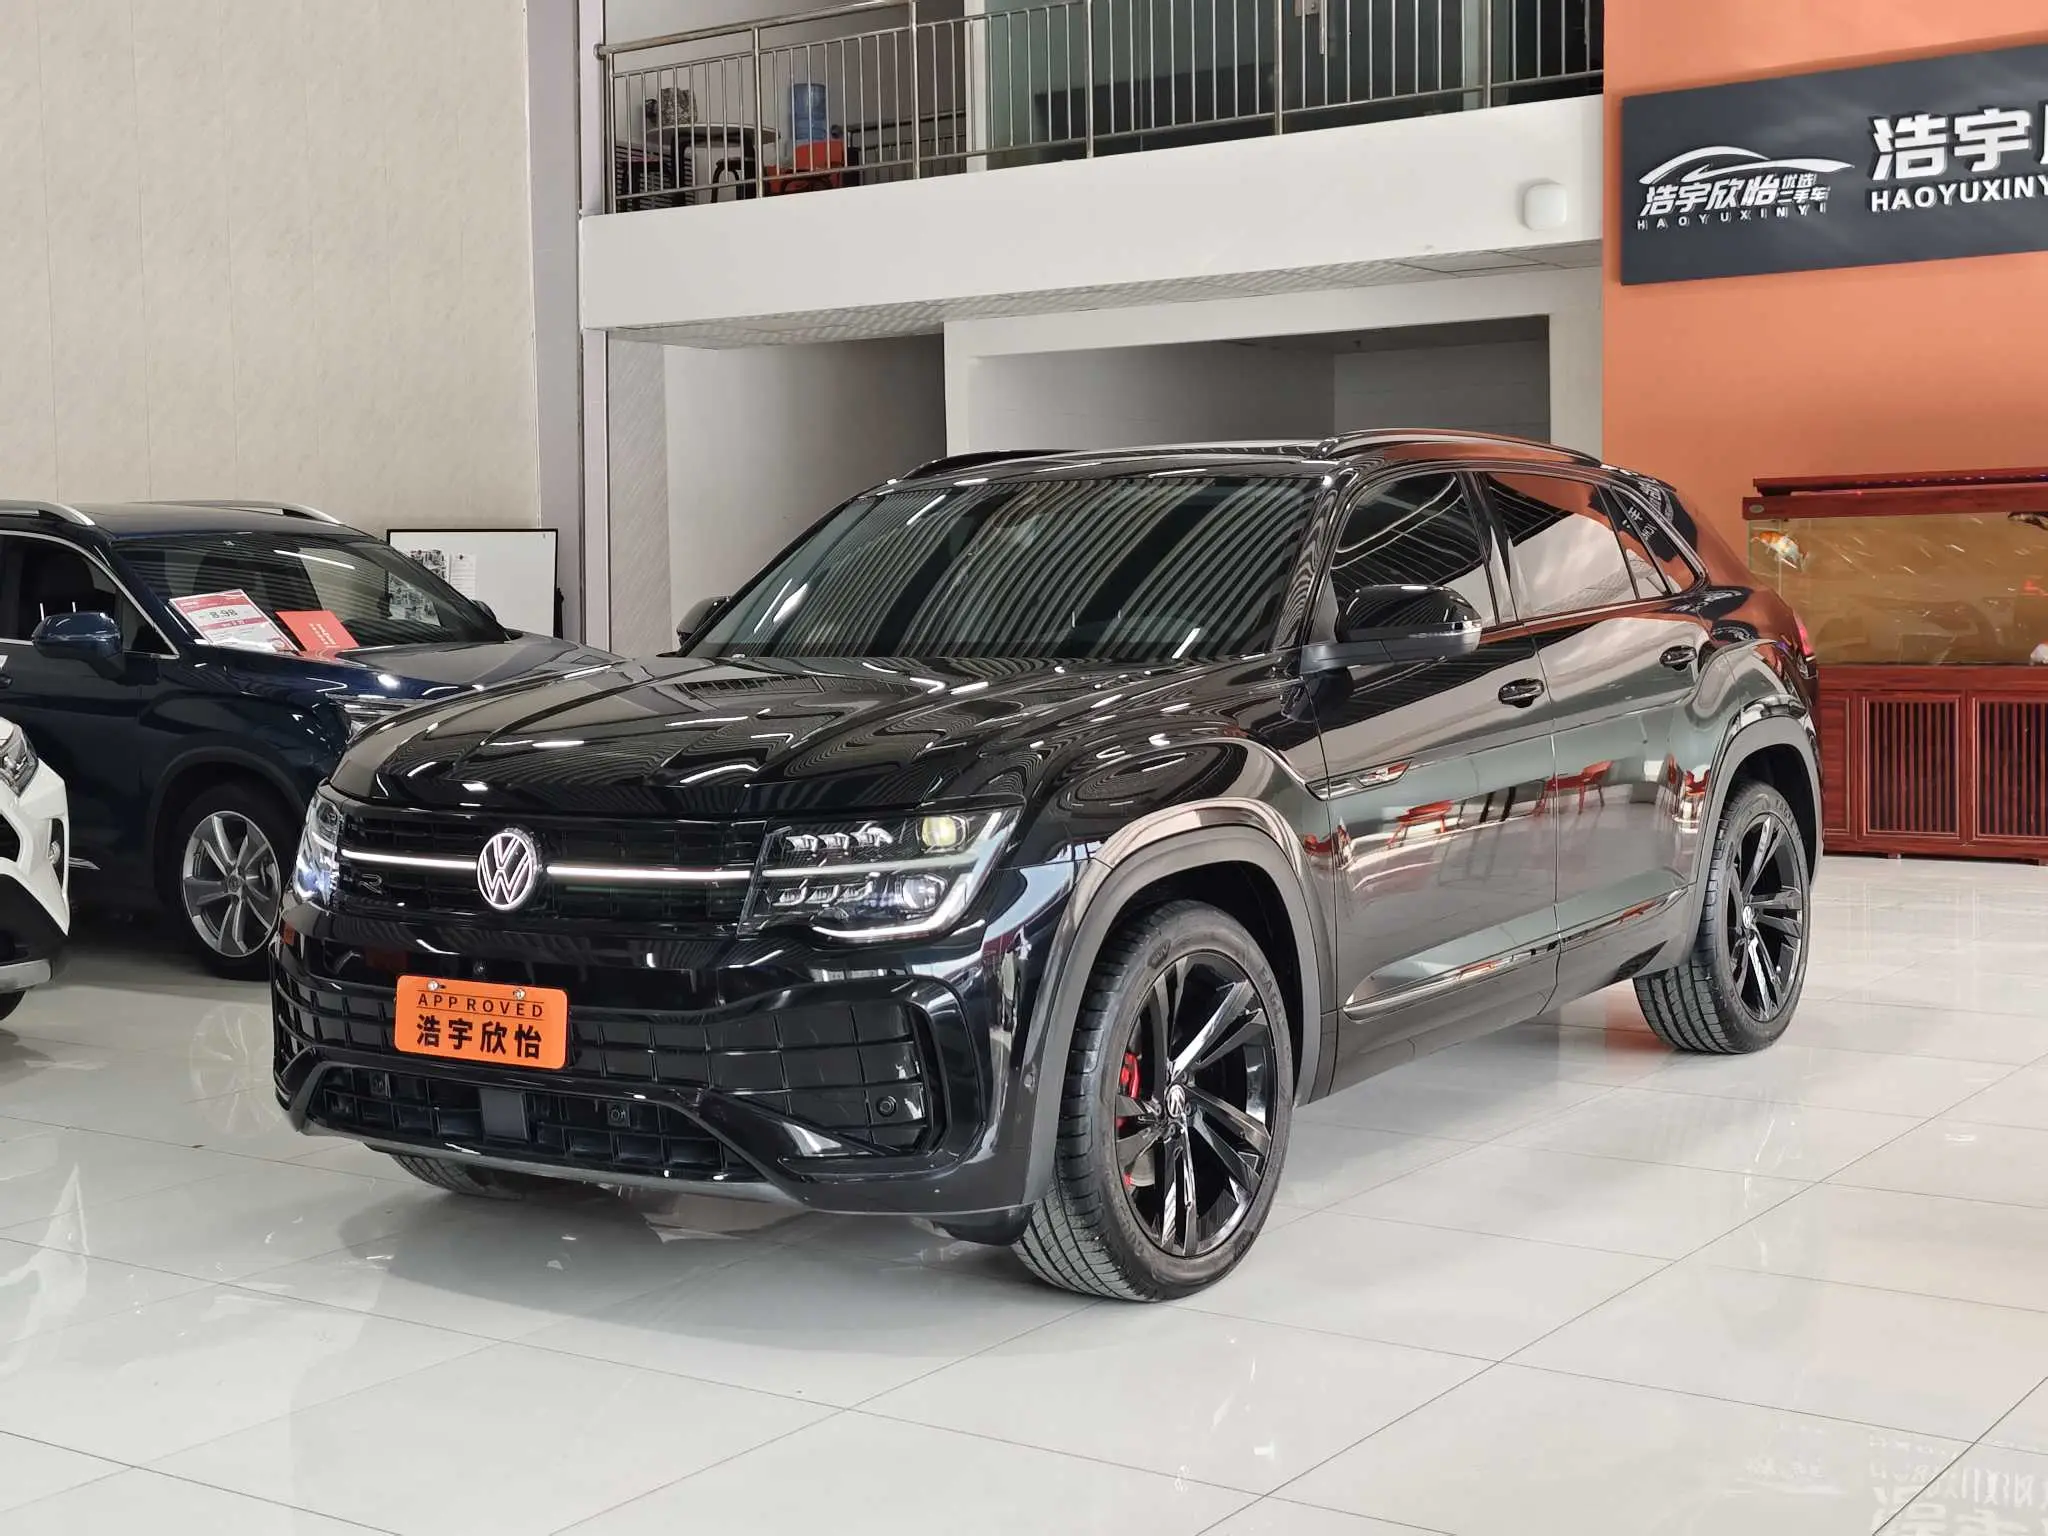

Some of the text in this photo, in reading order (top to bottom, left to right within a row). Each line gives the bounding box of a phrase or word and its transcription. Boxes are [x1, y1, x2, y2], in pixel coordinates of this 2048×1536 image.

[1872, 103, 2048, 181] 浩宇
[1639, 173, 1780, 217] 浩宇欣怡
[1777, 186, 1828, 204] 二手车
[1636, 203, 1827, 231] HAOYUXINYI
[208, 608, 238, 619] 8.98
[417, 993, 543, 1018] APPROVED
[416, 1013, 542, 1060] 浩宇欣怡
